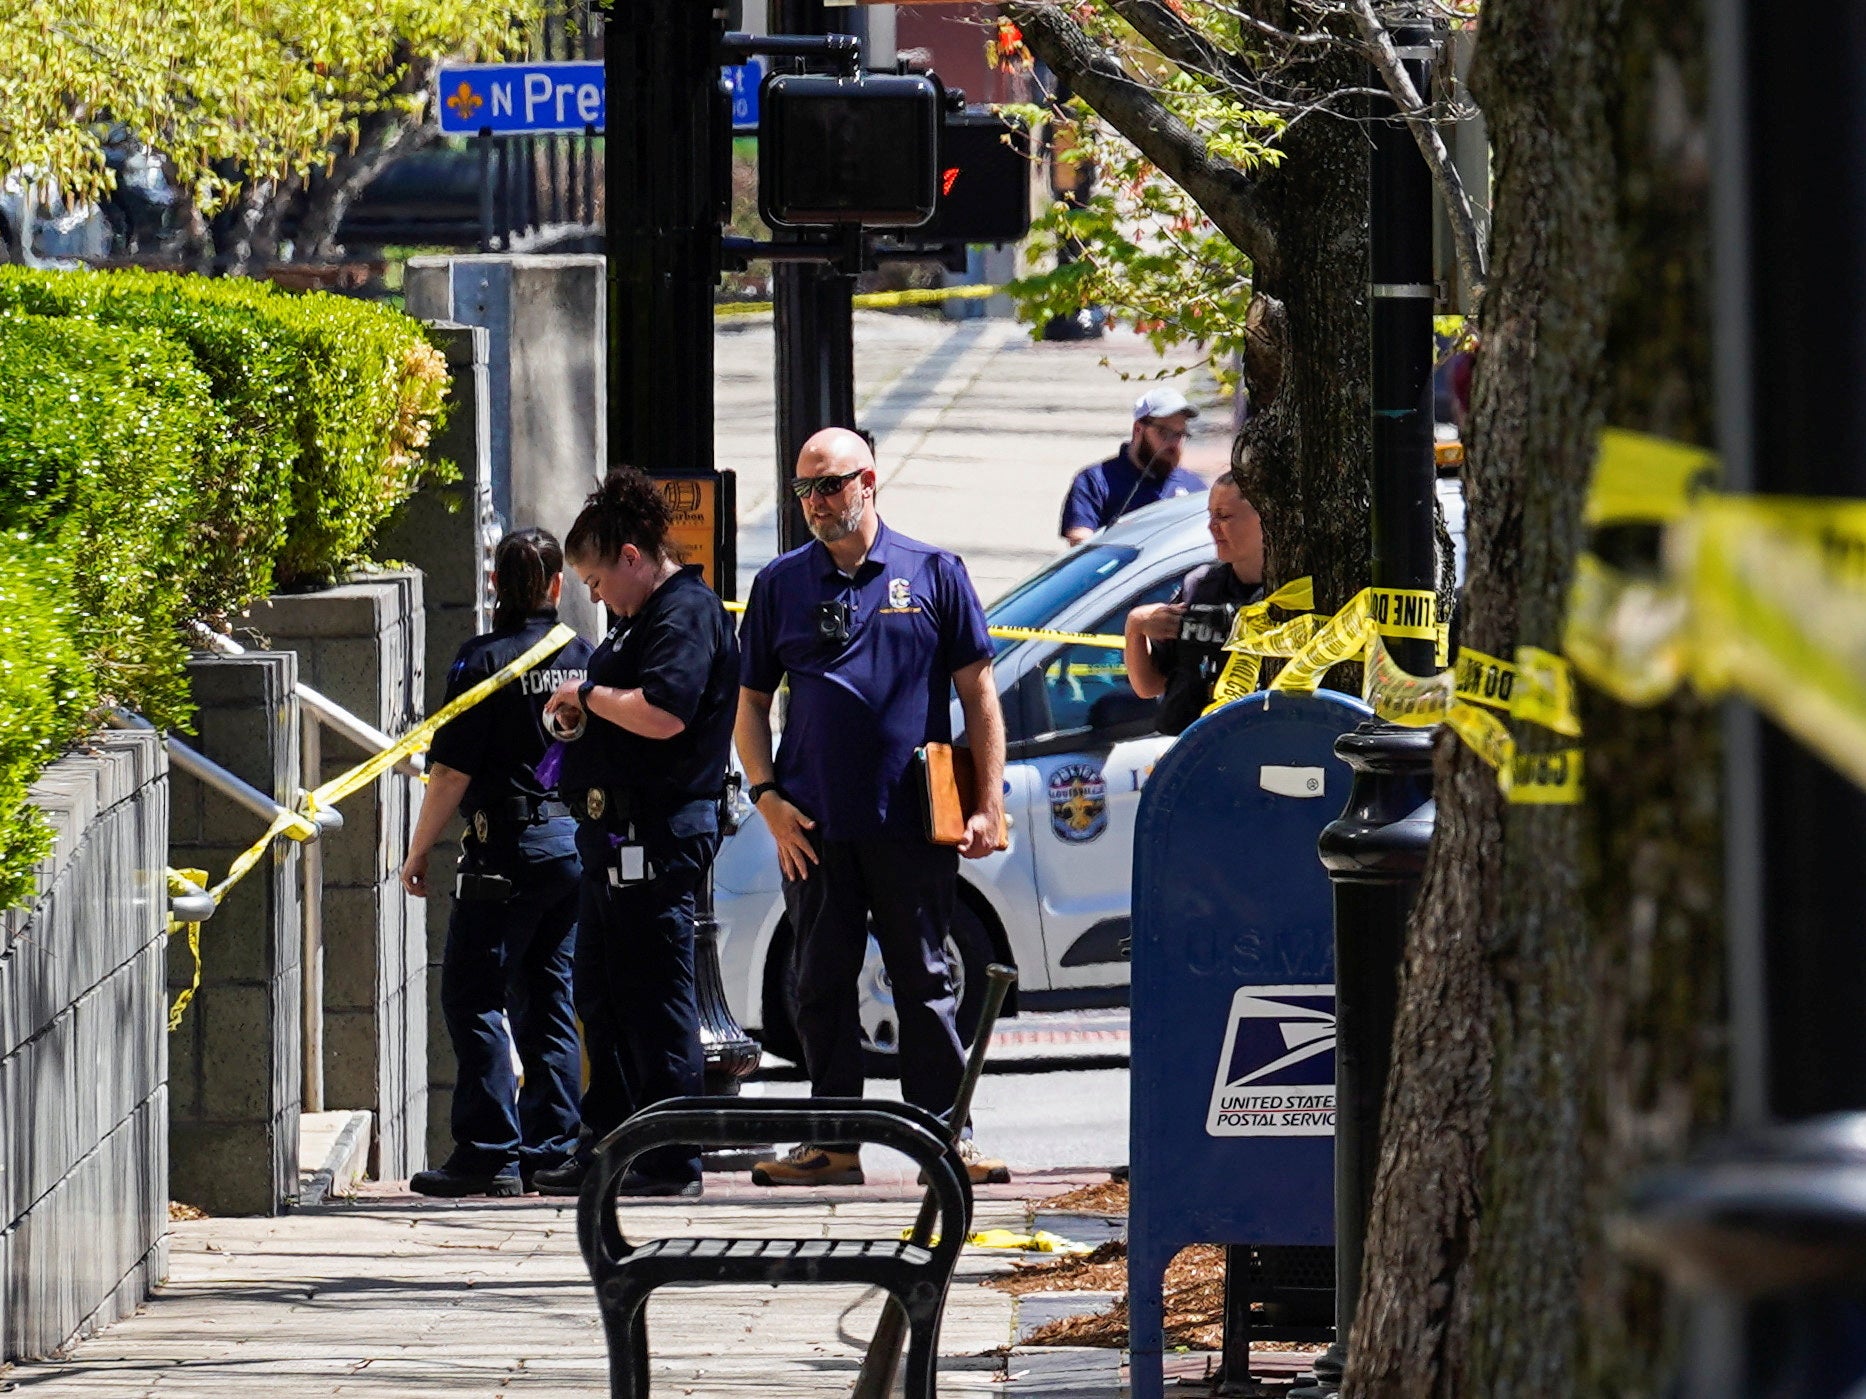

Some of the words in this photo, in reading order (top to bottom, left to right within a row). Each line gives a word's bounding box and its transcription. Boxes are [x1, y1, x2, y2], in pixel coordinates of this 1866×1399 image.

[490, 81, 513, 117] N
[524, 73, 605, 123] Pre
[1393, 594, 1430, 627] LINE
[1220, 1096, 1283, 1110] UNITED
[1285, 1095, 1336, 1109] STATE
[1217, 1113, 1278, 1127] POSTAL
